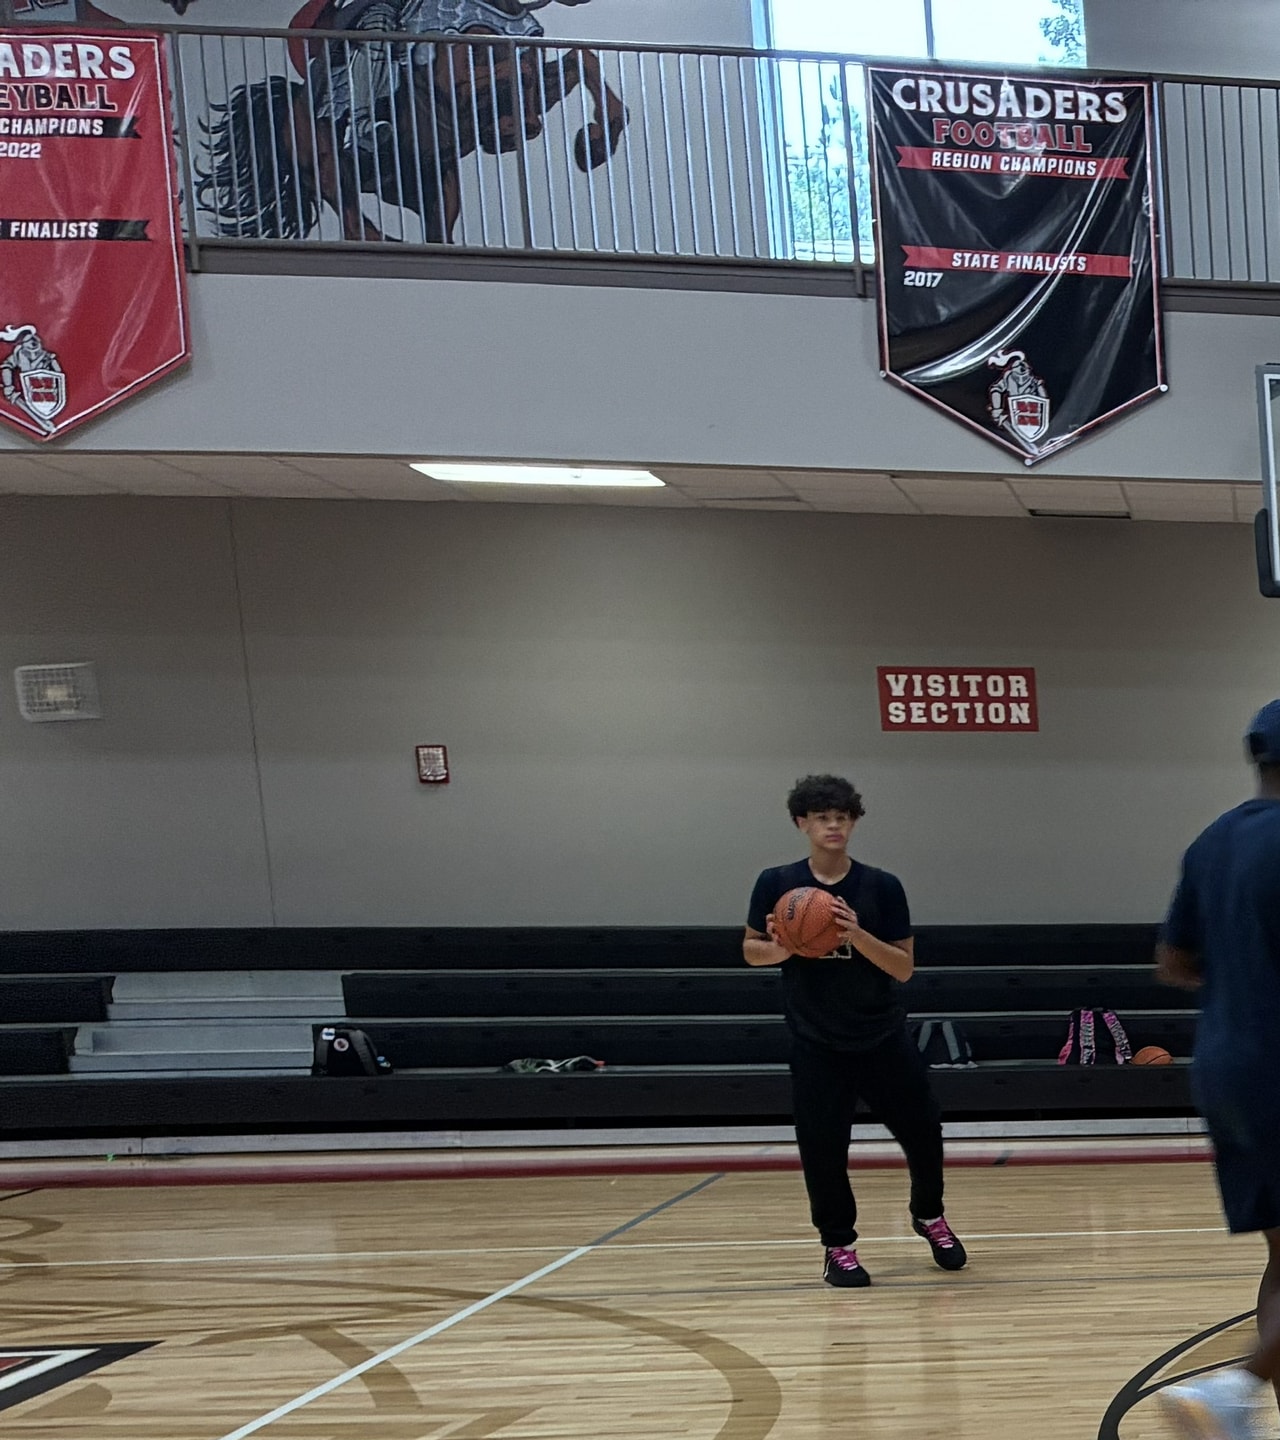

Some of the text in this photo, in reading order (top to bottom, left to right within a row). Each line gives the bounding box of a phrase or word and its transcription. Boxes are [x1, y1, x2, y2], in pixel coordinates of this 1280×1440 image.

[892, 78, 1127, 123] CRUSADERS
[0, 118, 104, 135] CHAMPIONS
[933, 119, 1092, 153] FOOTBALL
[931, 151, 1097, 176] REGION CHAMPIONS
[10, 222, 99, 238] FINALISTS
[952, 253, 1087, 272] STATE FINALISTS
[904, 271, 943, 288] 2017
[885, 674, 1028, 697] VISITOR
[888, 702, 1030, 723] SECTION
